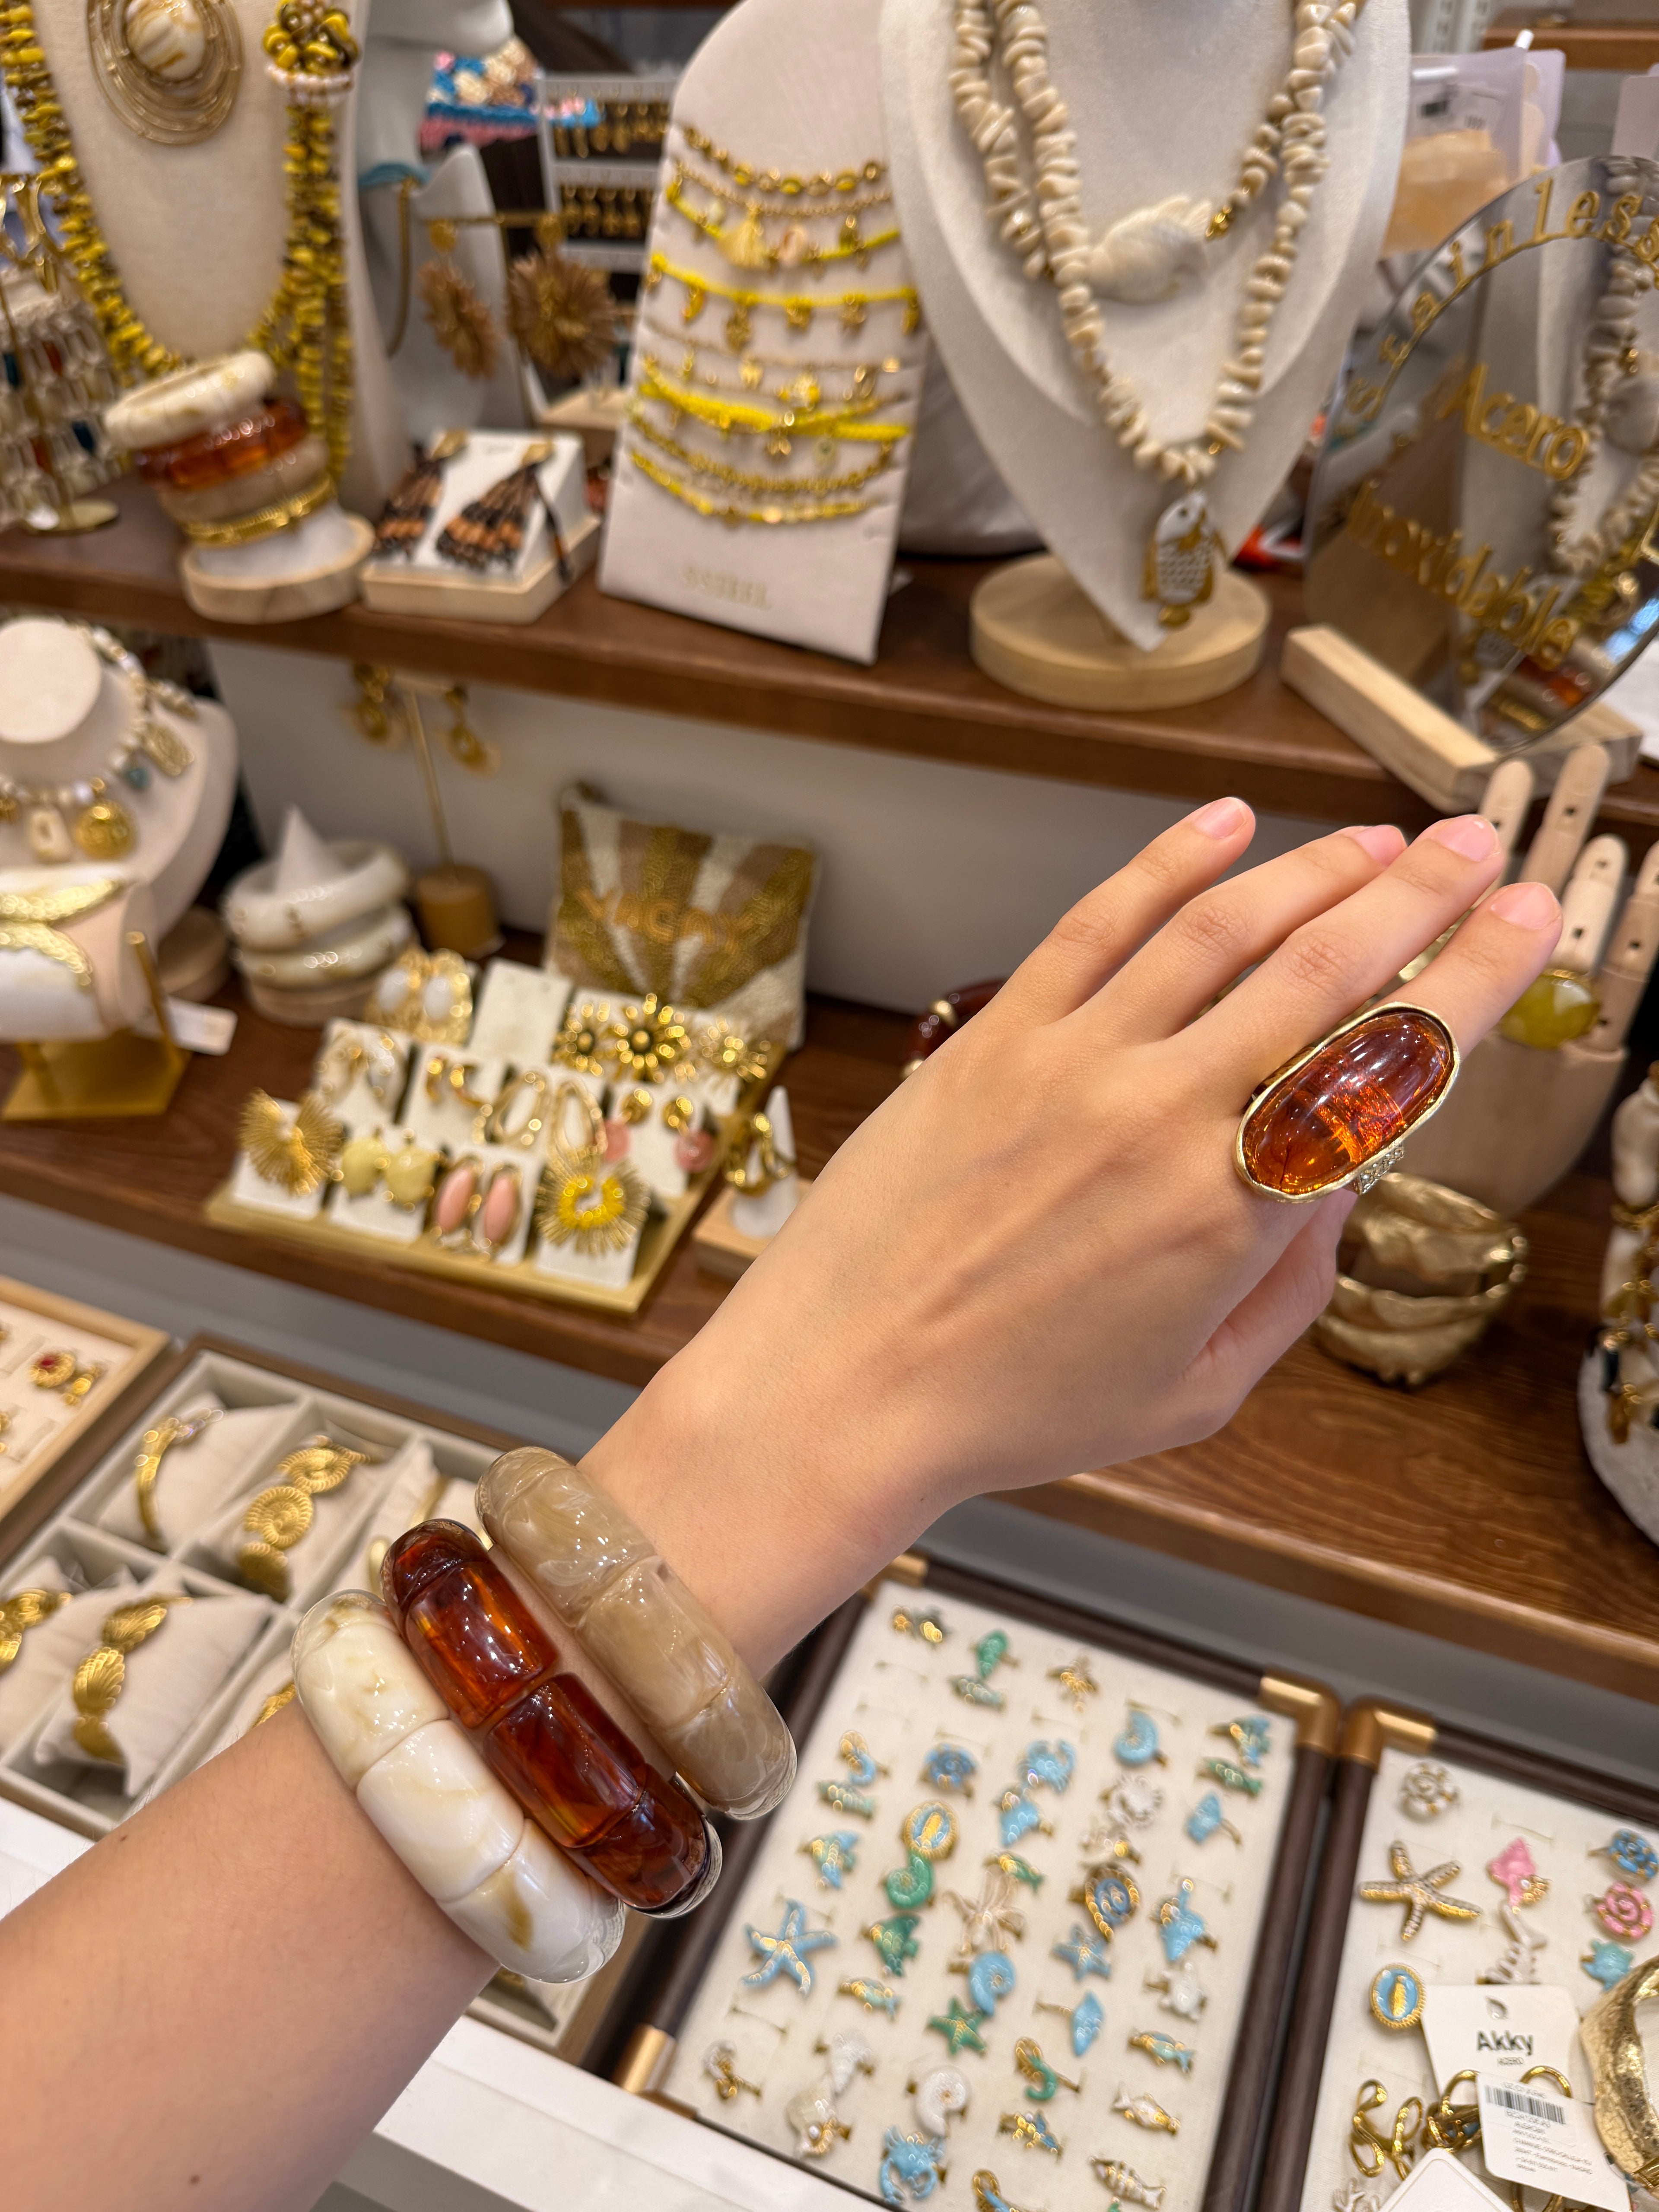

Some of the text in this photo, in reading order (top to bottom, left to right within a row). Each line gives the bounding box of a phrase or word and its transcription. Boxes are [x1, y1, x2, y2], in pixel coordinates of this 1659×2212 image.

[1437, 364, 1590, 480] Acero
[1347, 479, 1580, 671] Inoxidable
[1477, 2030, 1533, 2056] Akky
